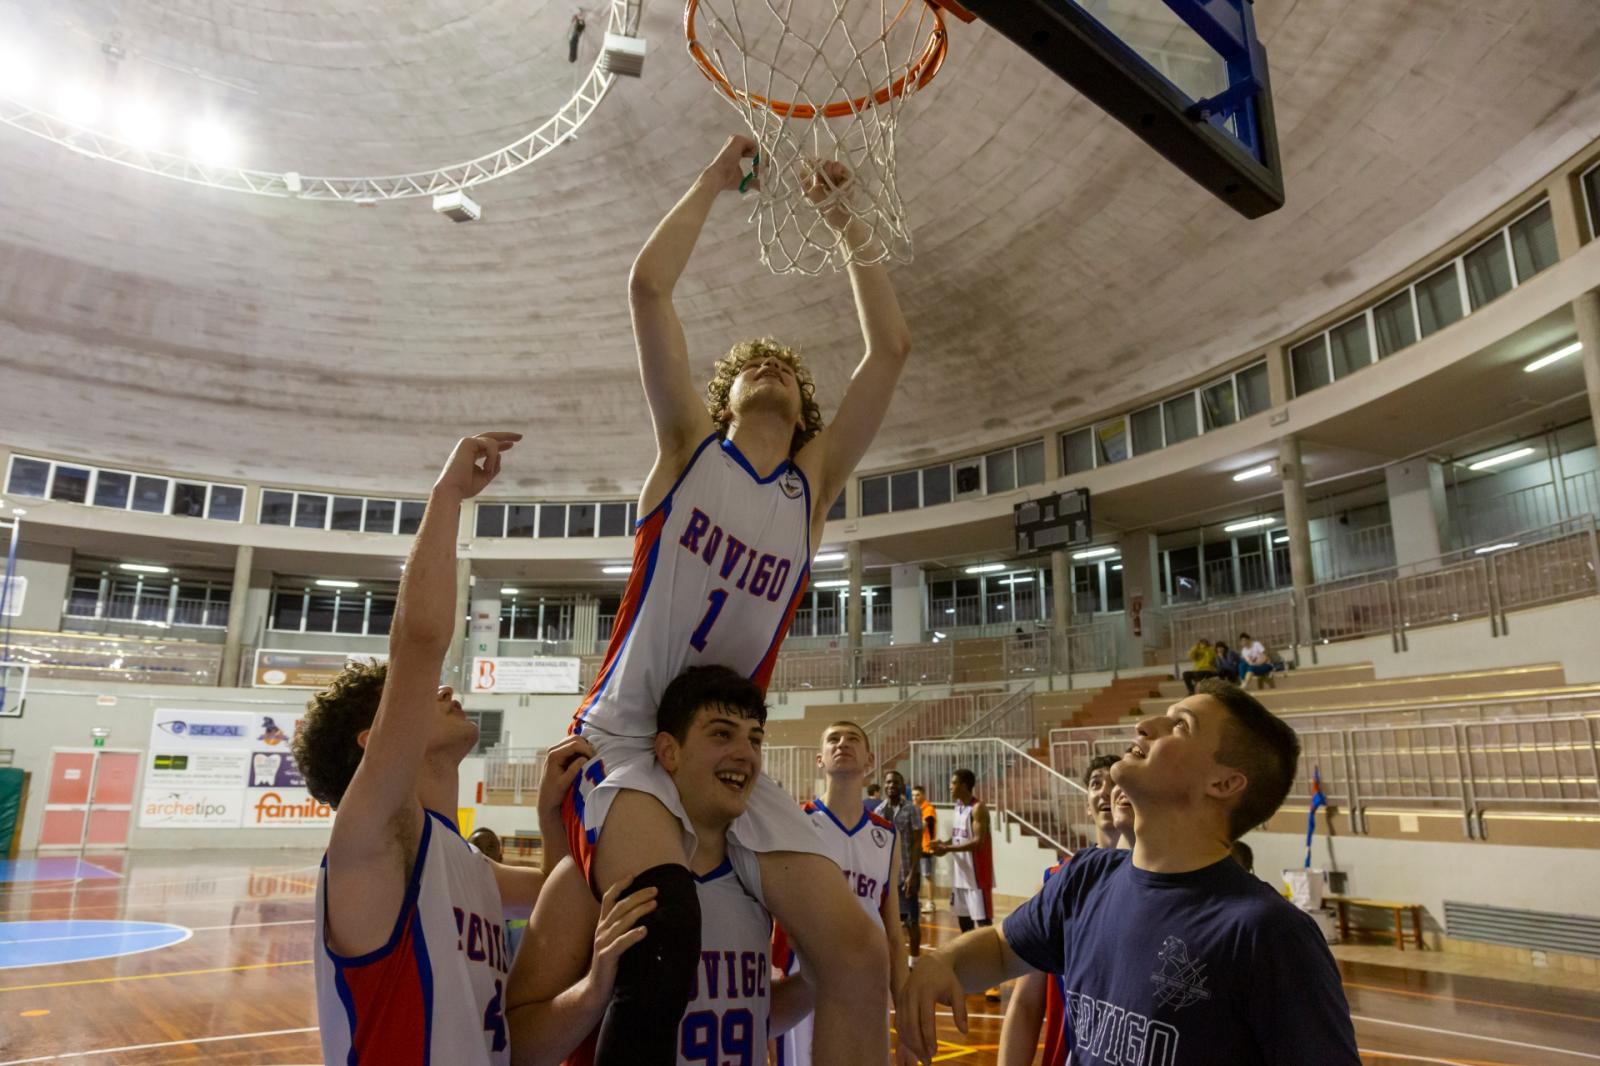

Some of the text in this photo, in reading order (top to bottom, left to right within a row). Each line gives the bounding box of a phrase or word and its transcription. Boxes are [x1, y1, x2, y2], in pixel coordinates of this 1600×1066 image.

[679, 507, 791, 602] ROVIGO
[689, 587, 729, 653] 1
[190, 724, 244, 737] SEKAL
[146, 799, 226, 817] archetipo
[254, 792, 331, 824] famila
[680, 1008, 754, 1066] 99
